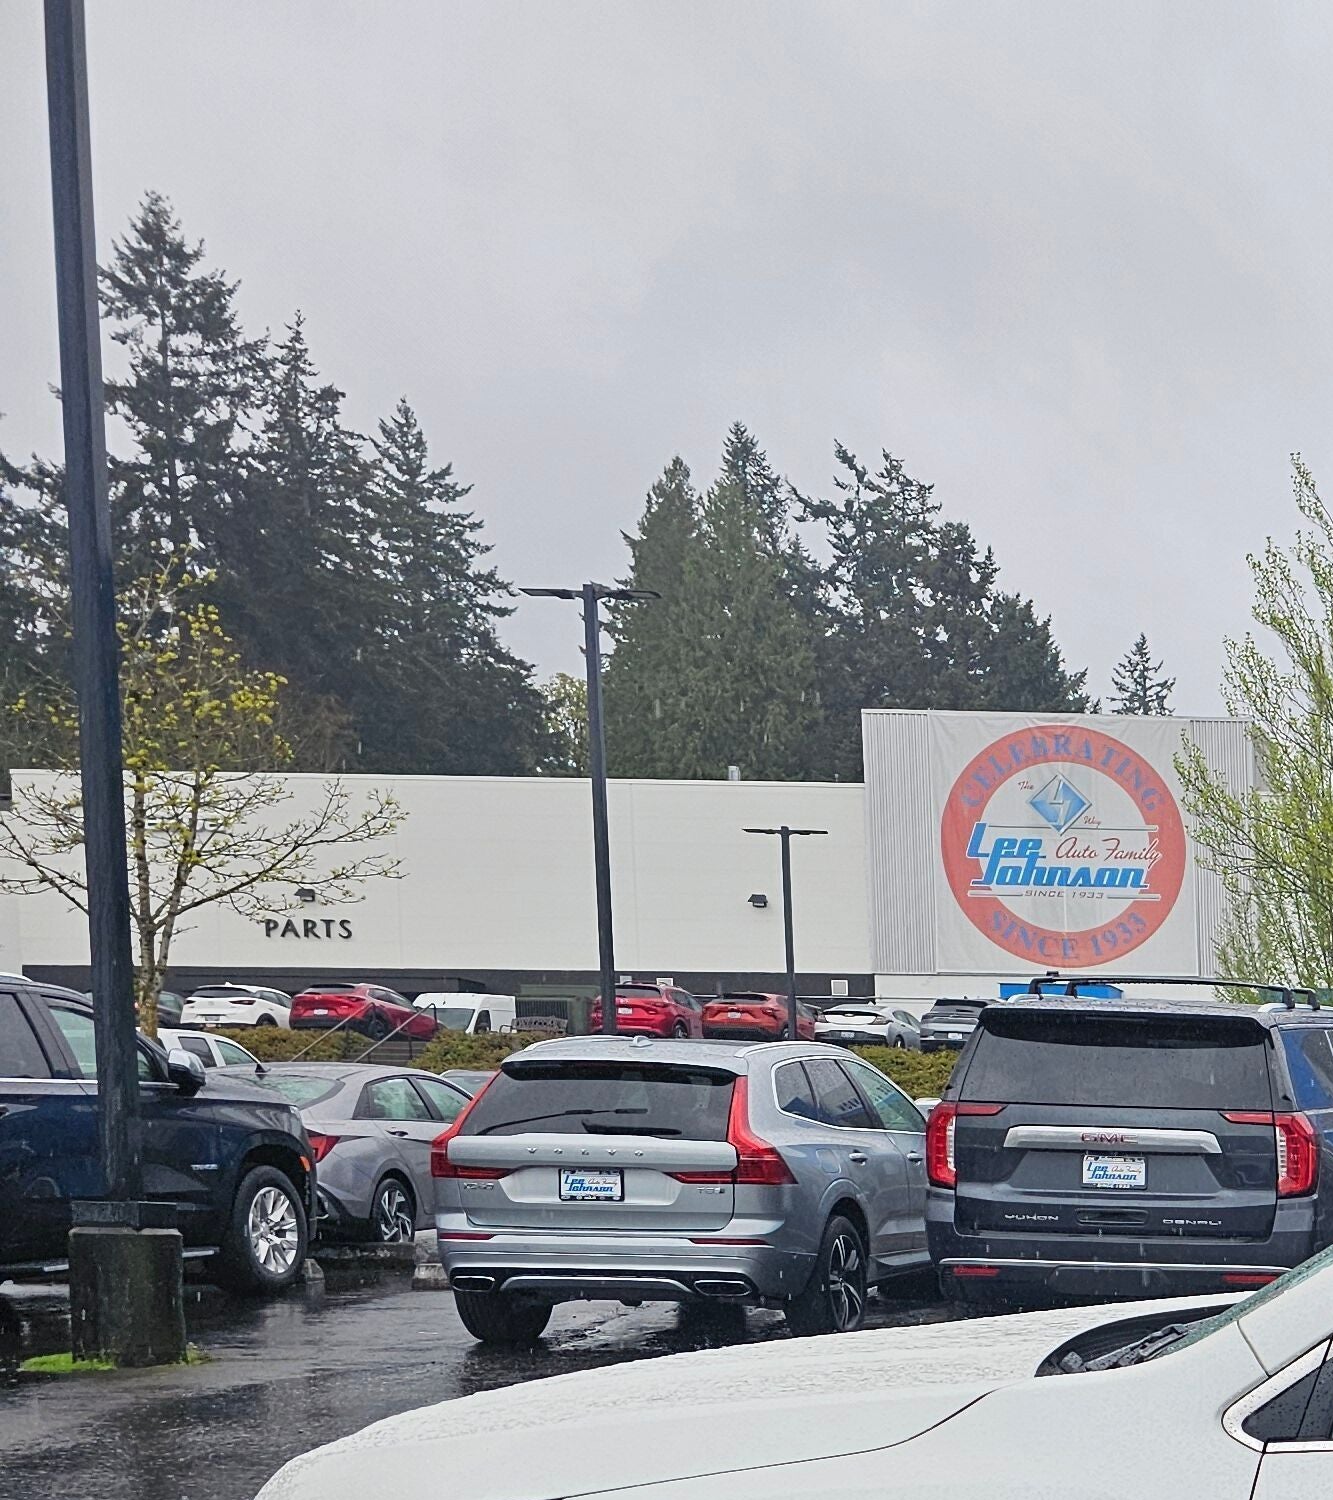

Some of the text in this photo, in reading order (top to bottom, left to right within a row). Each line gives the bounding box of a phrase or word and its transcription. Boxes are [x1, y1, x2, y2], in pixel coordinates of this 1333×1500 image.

[962, 733, 1162, 810] CELEBRATING
[1017, 780, 1035, 791] The
[967, 822, 1047, 859] Lee
[1056, 836, 1163, 869] Auto Family
[970, 851, 1149, 888] Johnson
[1024, 890, 1105, 899] SINCE 1933
[264, 918, 353, 939] PARTS
[990, 911, 1147, 960] SINCE 1933
[1081, 1132, 1139, 1145] GMC
[527, 1146, 644, 1157] VOLVO
[1086, 1161, 1109, 1172] Lee
[564, 1175, 586, 1185] Lee
[1088, 1169, 1138, 1180] Johnson
[1004, 1213, 1222, 1226] YUKON DENALI
